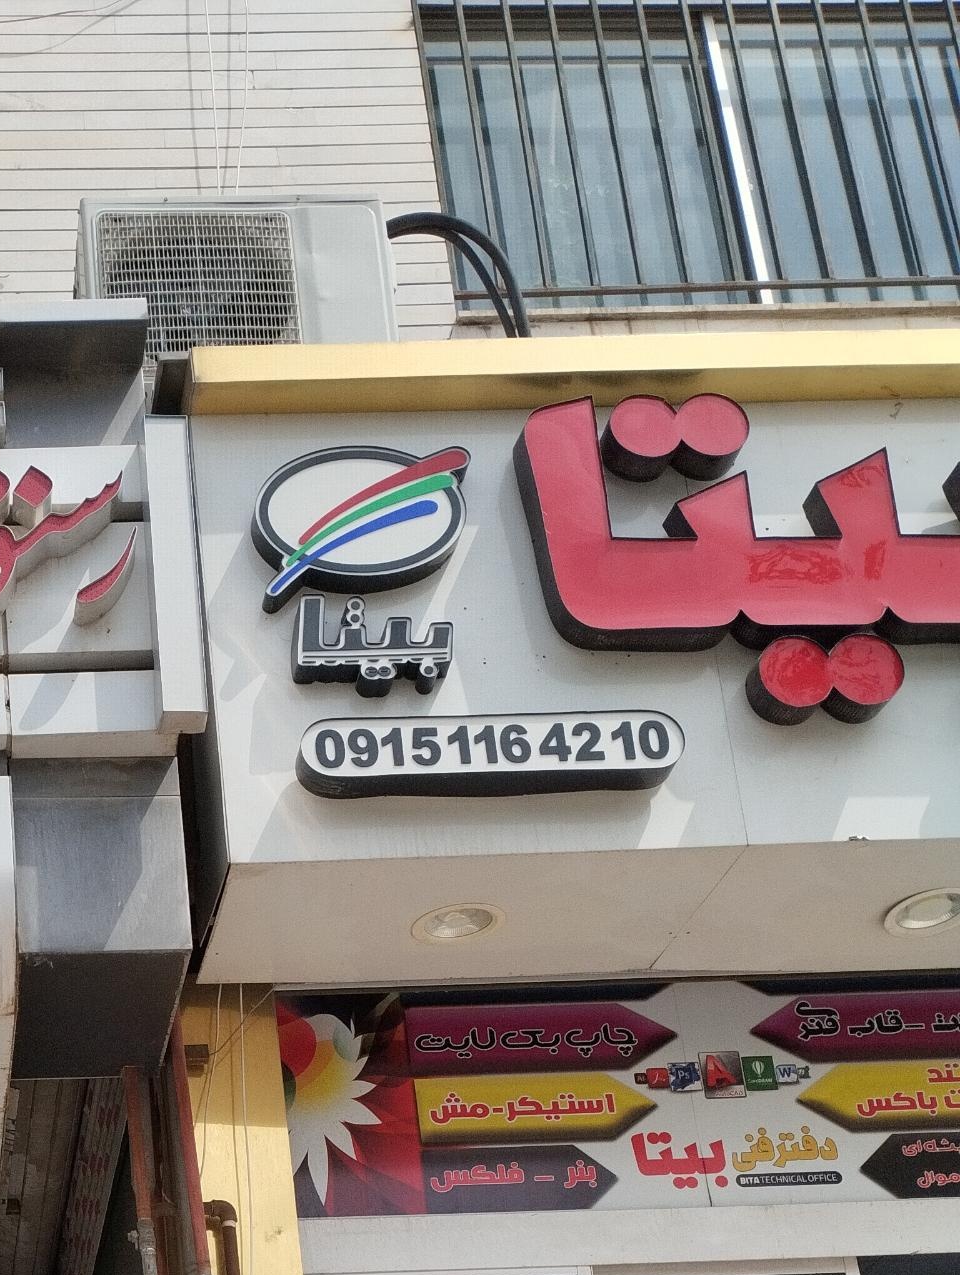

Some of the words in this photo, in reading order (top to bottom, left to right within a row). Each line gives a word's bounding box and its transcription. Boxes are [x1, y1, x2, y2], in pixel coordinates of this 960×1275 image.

[414, 1027, 497, 1059] لایت
[500, 1028, 561, 1055] بک
[565, 1022, 639, 1057] چاپ
[856, 1091, 938, 1118] باکس
[564, 1160, 597, 1189] بنر
[630, 1132, 729, 1190] بیتا
[430, 1162, 525, 1193] فلکس
[759, 1174, 807, 1184] TECHNICAL
[807, 1173, 838, 1182] OFFICE
